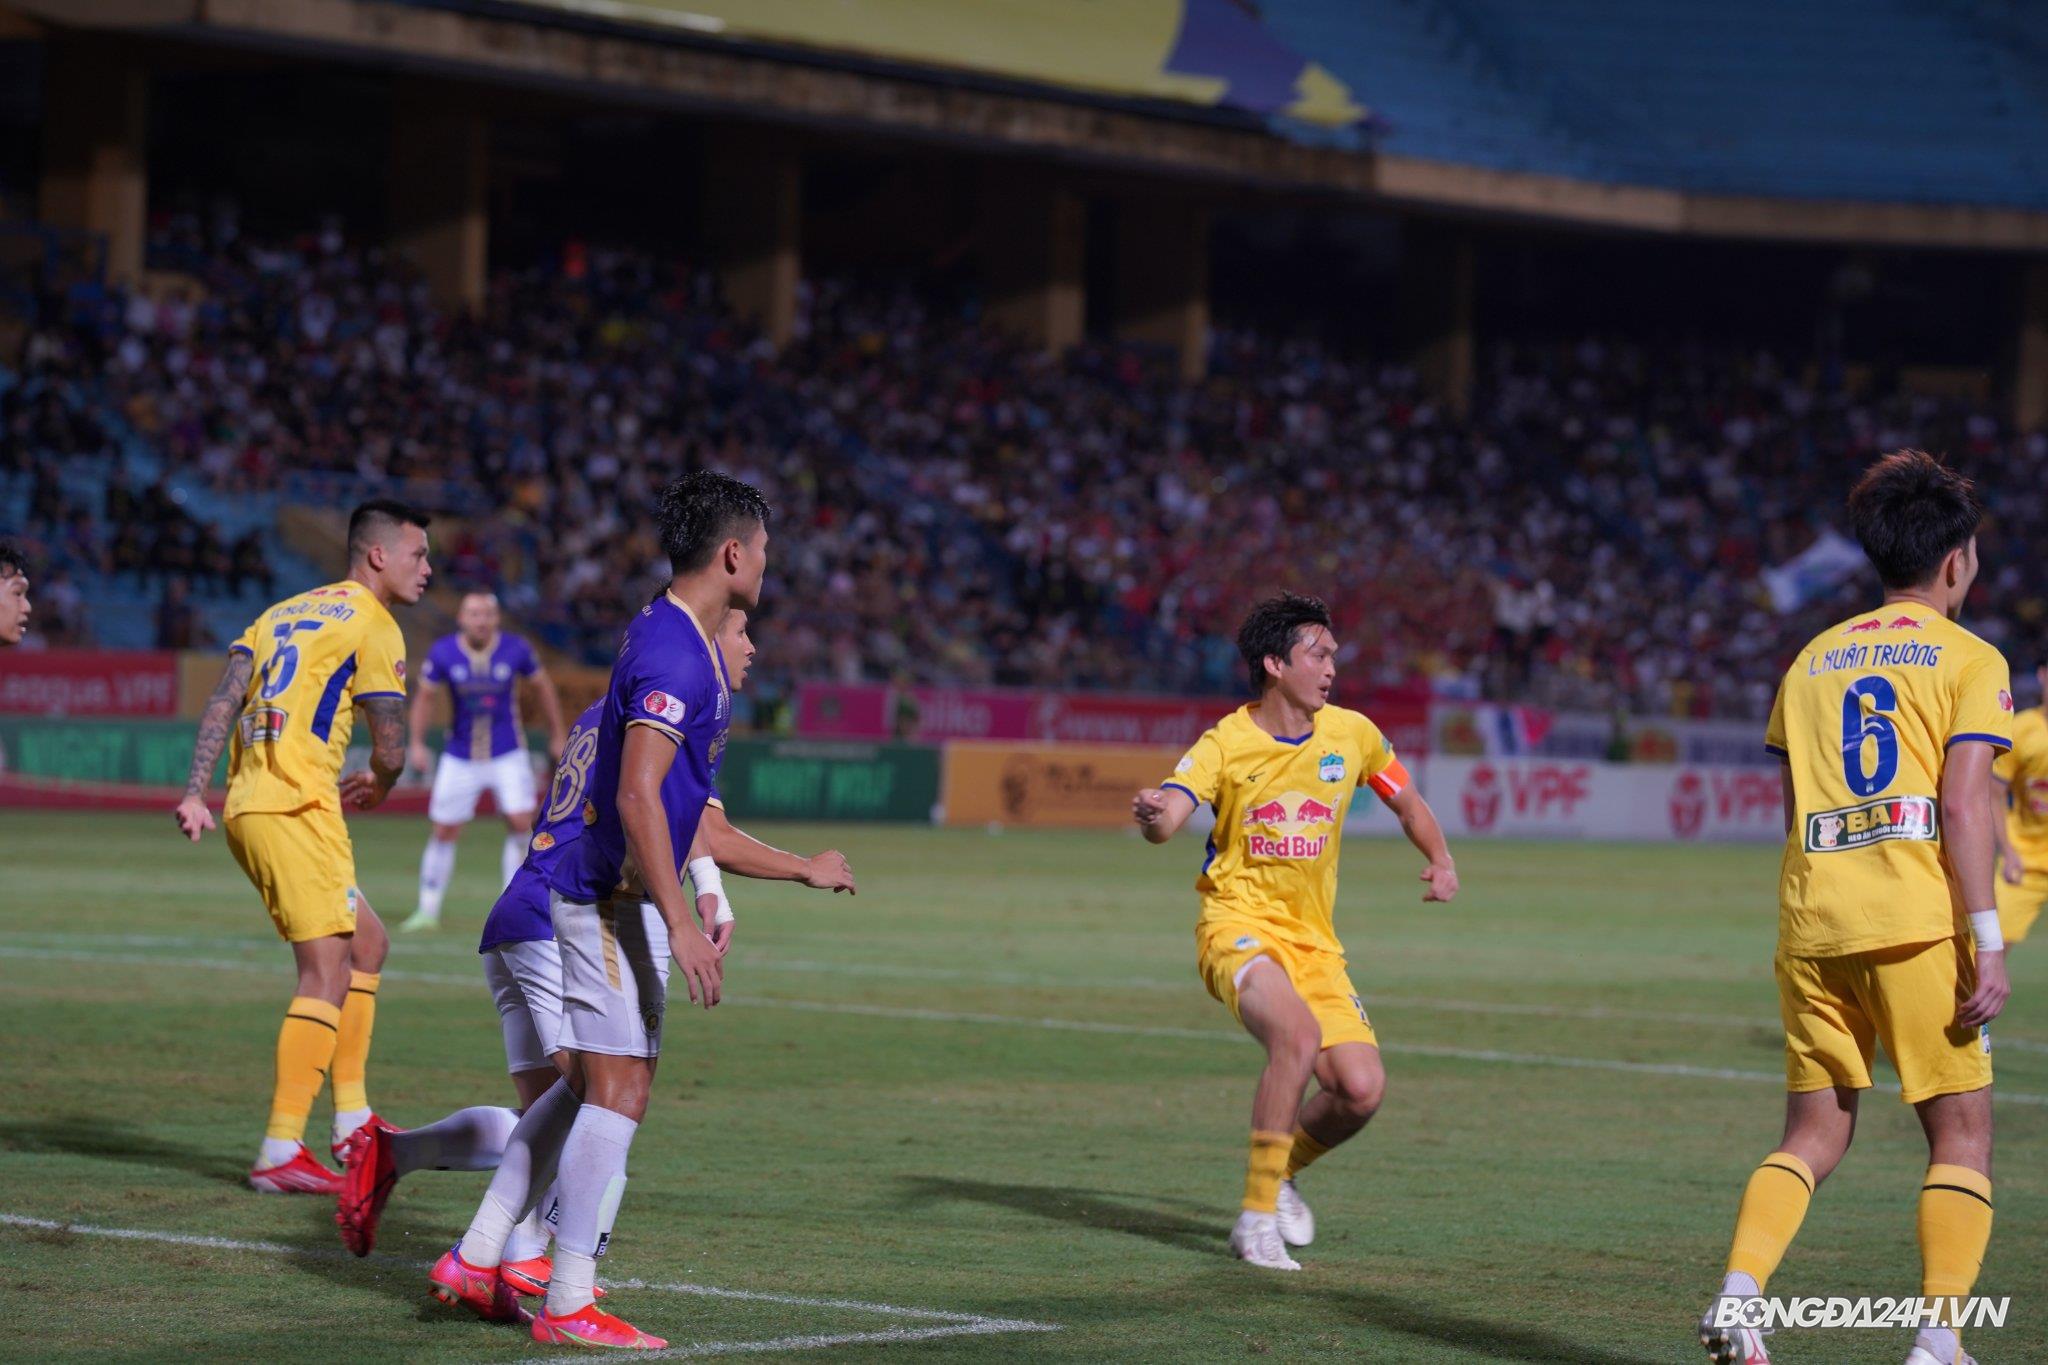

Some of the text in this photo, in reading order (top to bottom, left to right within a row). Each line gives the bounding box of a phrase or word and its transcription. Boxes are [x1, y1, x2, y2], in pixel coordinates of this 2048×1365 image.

[1842, 675, 1899, 797] 6
[1508, 764, 1592, 816] VPF
[1250, 835, 1289, 857] Red
